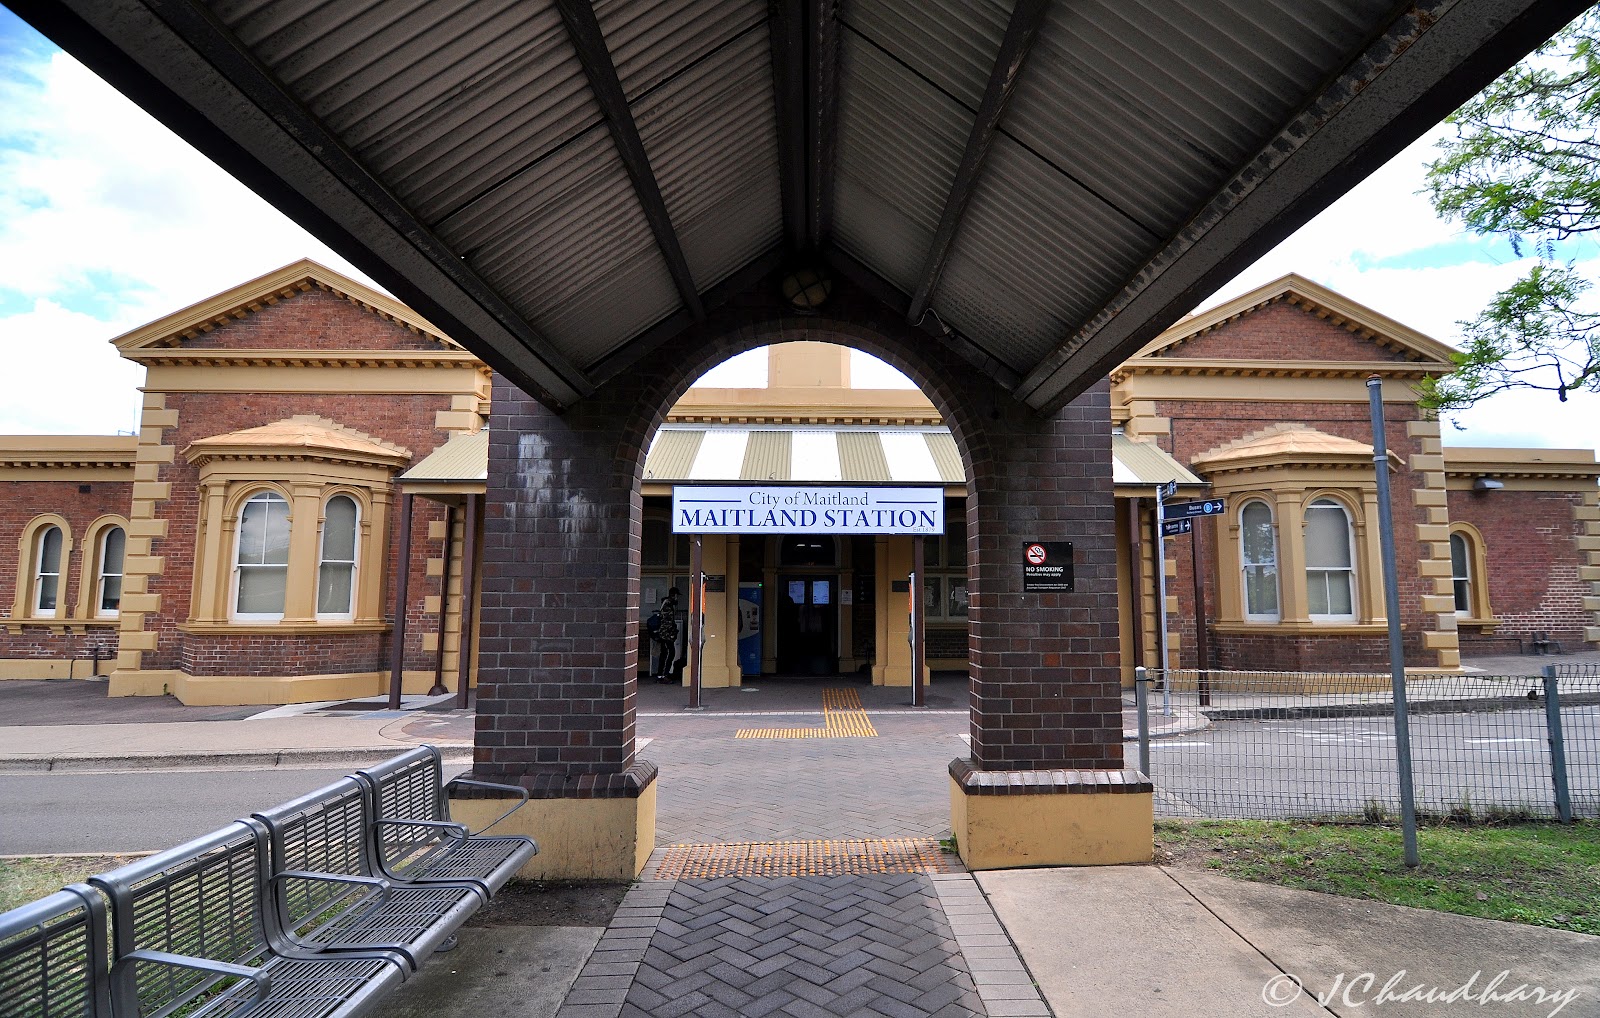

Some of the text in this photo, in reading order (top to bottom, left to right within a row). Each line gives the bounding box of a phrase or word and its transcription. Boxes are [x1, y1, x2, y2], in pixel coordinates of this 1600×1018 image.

[749, 491, 869, 510] City of Maitland
[678, 508, 938, 528] MAITLAND STATION
